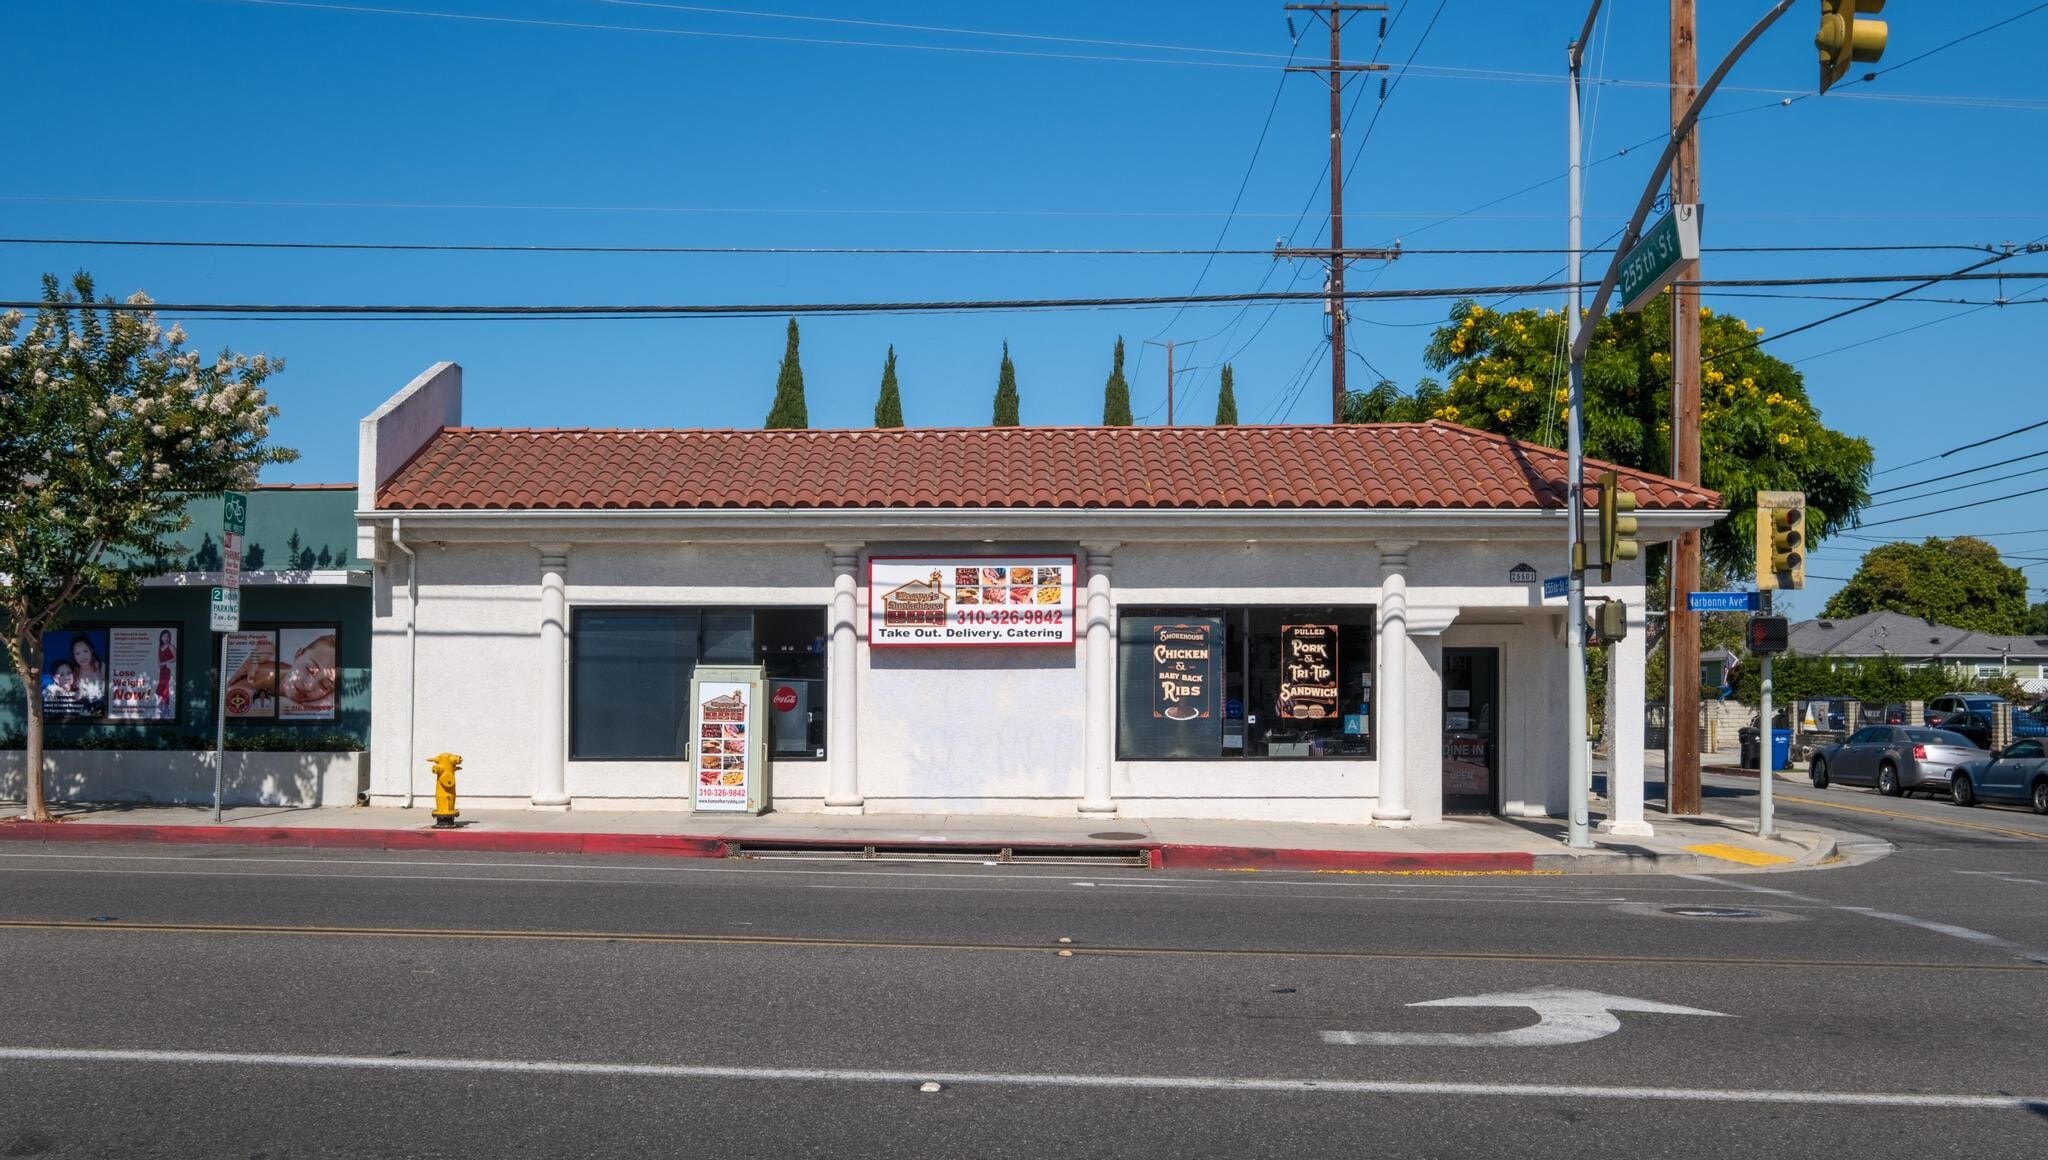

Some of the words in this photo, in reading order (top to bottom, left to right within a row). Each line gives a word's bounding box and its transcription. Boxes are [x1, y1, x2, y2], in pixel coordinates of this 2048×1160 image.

[1623, 248, 1656, 293] 255th
[1659, 231, 1673, 258] St
[214, 590, 221, 599] 2
[1728, 596, 1743, 607] Ave
[213, 604, 239, 613] PARKING
[957, 610, 1064, 625] 310-326-9842
[879, 629, 911, 638] Take
[915, 629, 942, 638] Out.
[946, 629, 1003, 640] Delivery.
[1007, 629, 1063, 640] Catering
[1160, 630, 1205, 642] SMOKEHOUSE
[1294, 628, 1326, 636] PULLED
[1154, 644, 1208, 664] CHICKEN
[1291, 639, 1328, 659] PORK
[1303, 654, 1315, 663] &
[1175, 661, 1187, 671] &
[113, 669, 136, 677] Lose
[1158, 672, 1180, 680] BABY
[1181, 674, 1203, 682] BACK
[113, 679, 145, 688] Weight
[112, 689, 152, 700] Now!
[1161, 681, 1201, 702] RIBS
[1280, 683, 1338, 702] SANDWICH
[1347, 719, 1357, 730] A
[1442, 744, 1470, 755] DINE
[1472, 744, 1485, 755] IN
[698, 789, 746, 797] 310-326-9842
